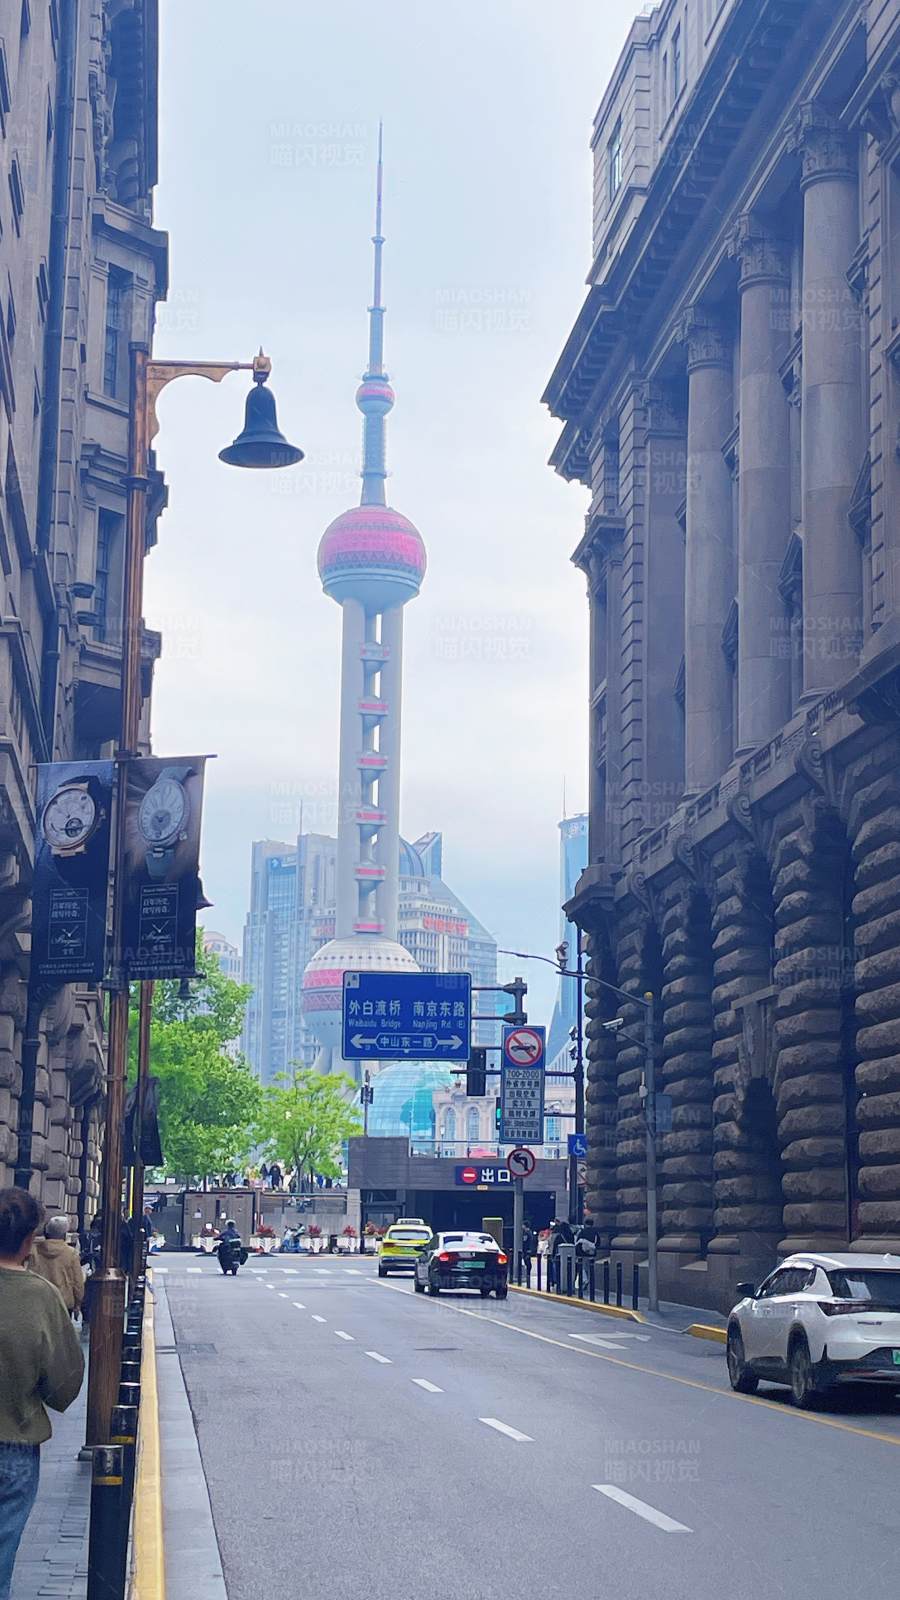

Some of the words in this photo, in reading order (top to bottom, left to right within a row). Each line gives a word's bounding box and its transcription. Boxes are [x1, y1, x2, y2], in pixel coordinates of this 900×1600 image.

[349, 1000, 401, 1016] 外白渡桥
[413, 1001, 465, 1017] 南京东路
[349, 1019, 377, 1028] Waibaidu
[381, 1019, 401, 1029] Bridge
[380, 1037, 433, 1048] 中山东一路
[481, 1168, 511, 1183] 出口
